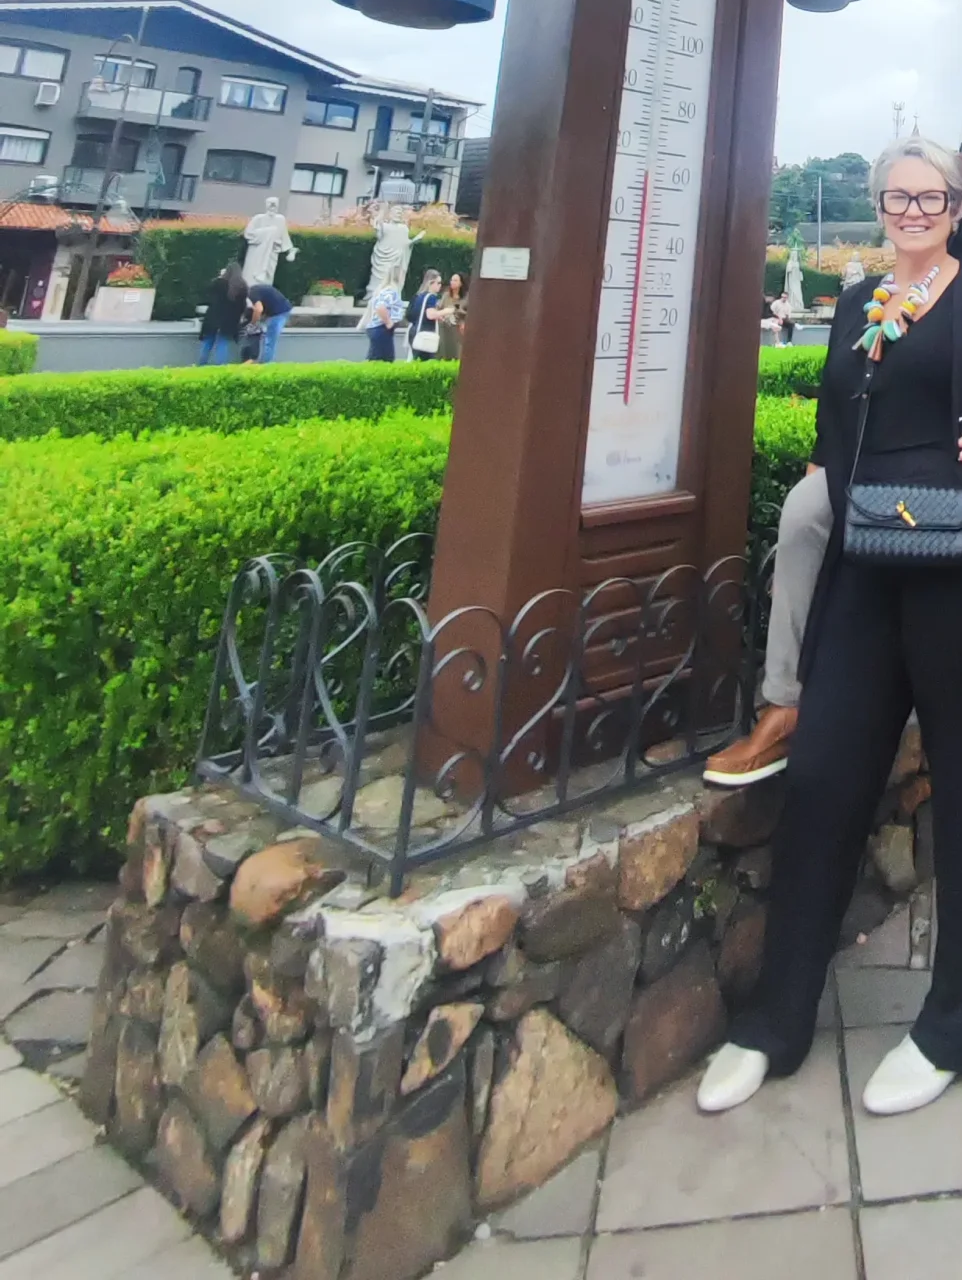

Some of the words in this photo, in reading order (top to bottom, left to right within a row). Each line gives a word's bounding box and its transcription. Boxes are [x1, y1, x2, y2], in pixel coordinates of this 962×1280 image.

[681, 35, 704, 55] 100
[678, 101, 696, 120] 80
[671, 166, 691, 186] 60
[665, 237, 685, 255] 40
[659, 307, 678, 327] 20
